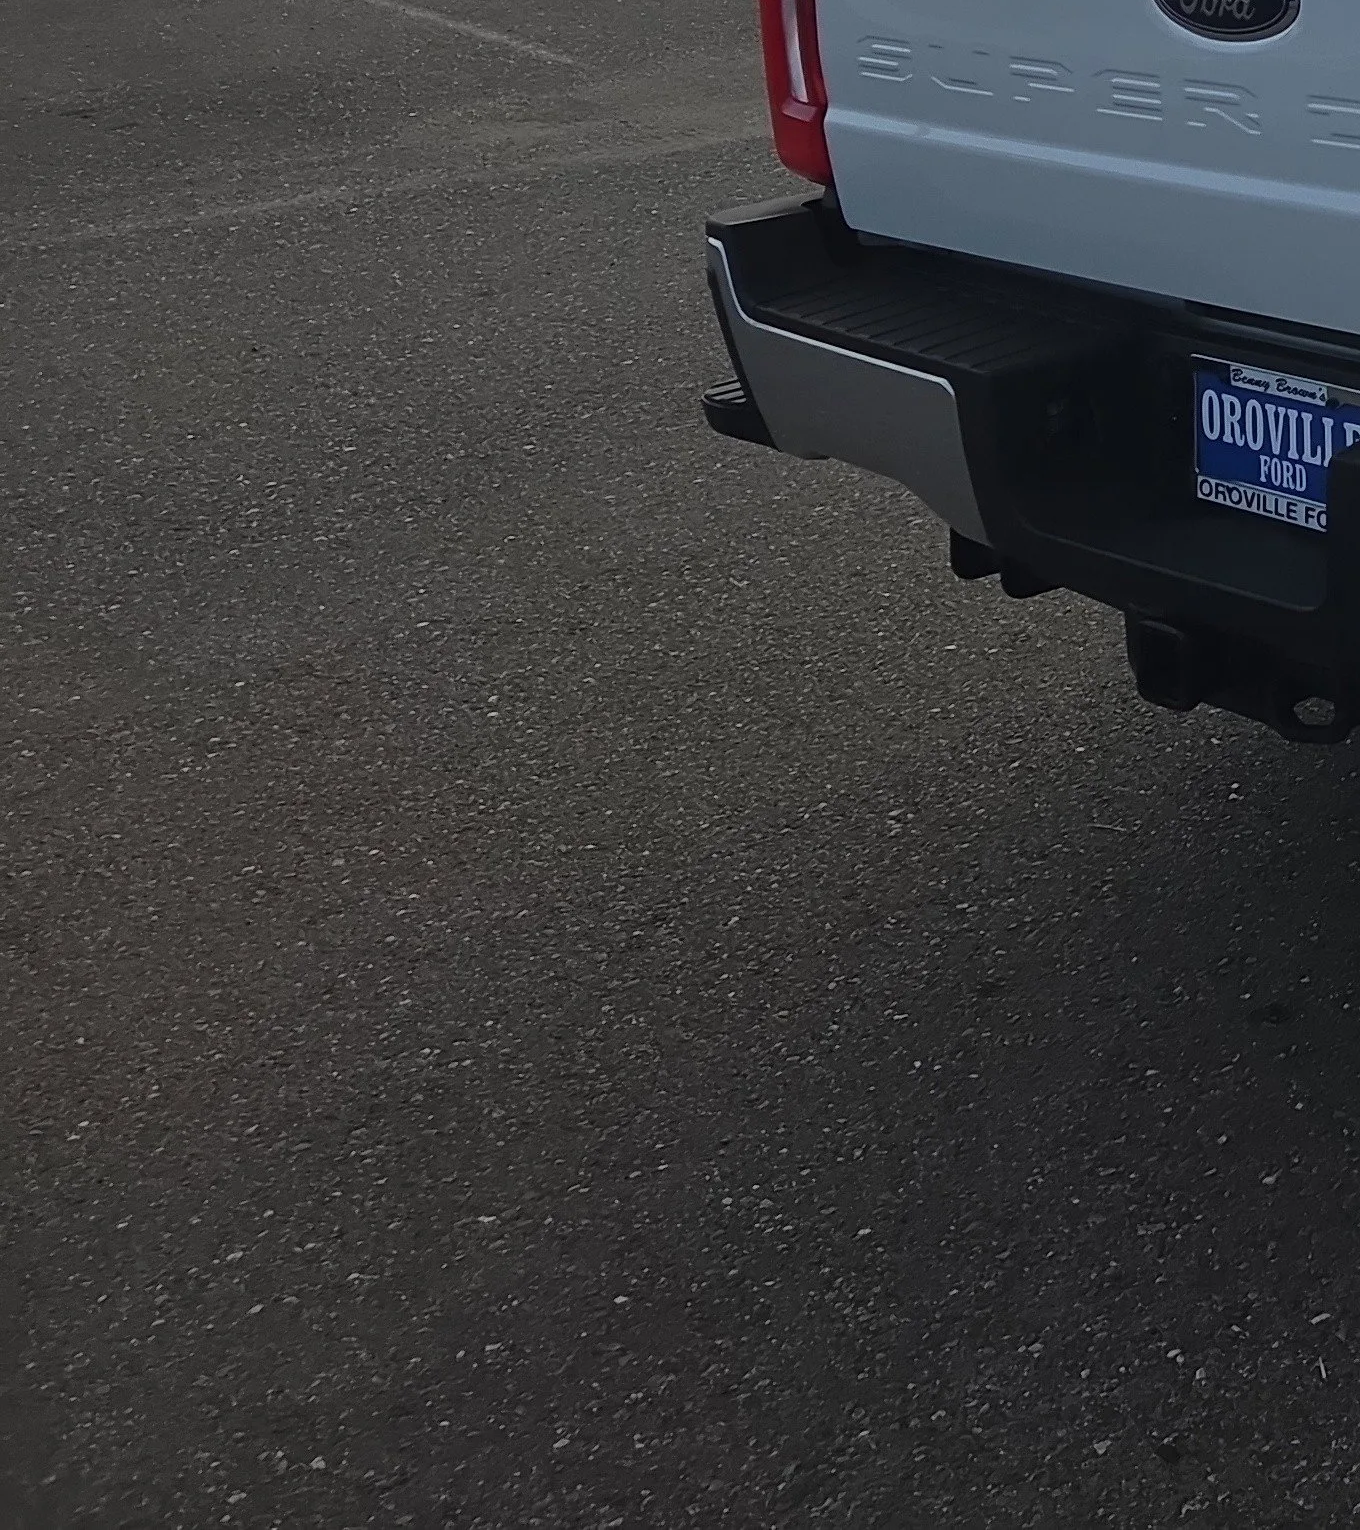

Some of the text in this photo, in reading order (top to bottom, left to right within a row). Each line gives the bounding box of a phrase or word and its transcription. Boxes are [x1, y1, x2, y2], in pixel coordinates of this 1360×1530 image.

[857, 35, 1261, 136] SUPER
[1232, 368, 1327, 401] Benny Brown's
[1260, 455, 1307, 492] FORD
[1200, 478, 1298, 521] OROVILLE
